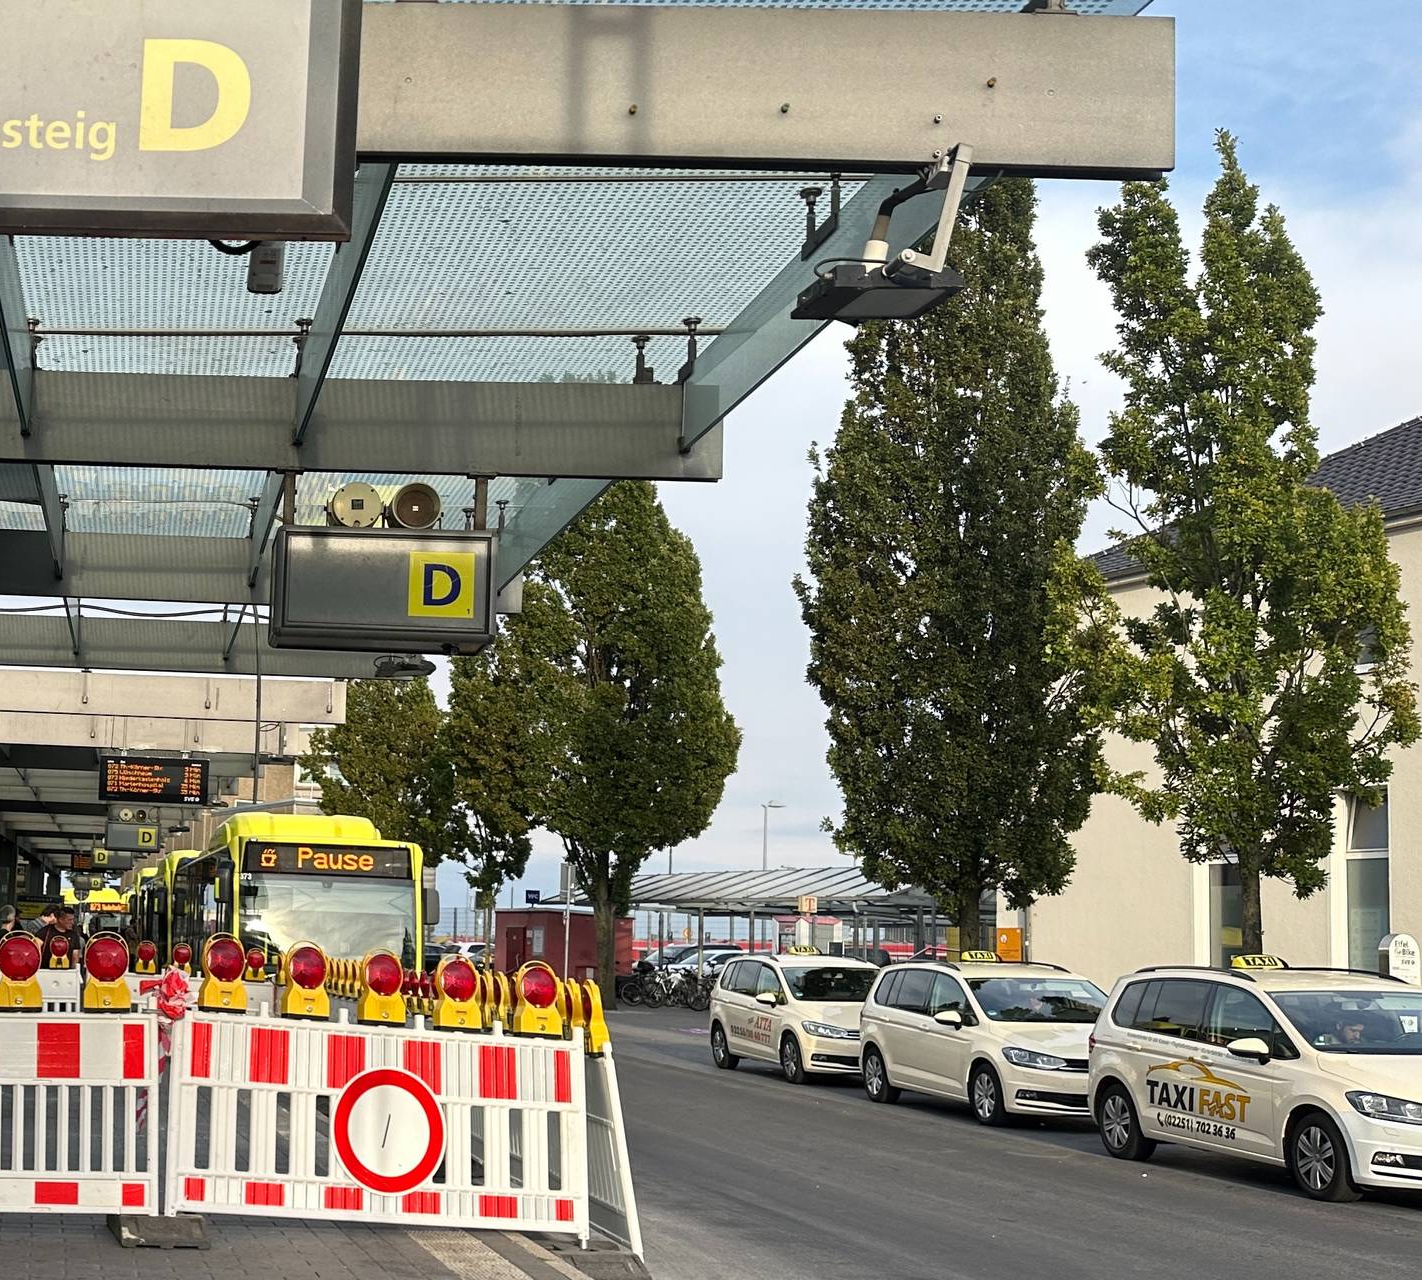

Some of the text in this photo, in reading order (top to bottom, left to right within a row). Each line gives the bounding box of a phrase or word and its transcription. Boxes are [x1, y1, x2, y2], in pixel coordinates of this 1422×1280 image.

[138, 37, 252, 153] D
[423, 564, 461, 606] D
[142, 832, 152, 843] D
[98, 852, 106, 862] D
[297, 847, 375, 872] Pause
[805, 898, 816, 913] T
[794, 946, 814, 954] TAXI
[1394, 940, 1409, 948] Eifel
[969, 952, 993, 960] TAXI
[1249, 956, 1276, 966] TAXI
[1146, 1079, 1251, 1123] TAXI FAST
[1196, 1121, 1212, 1135] 702
[1212, 1125, 1224, 1137] 36
[1225, 1127, 1236, 1140] 36
